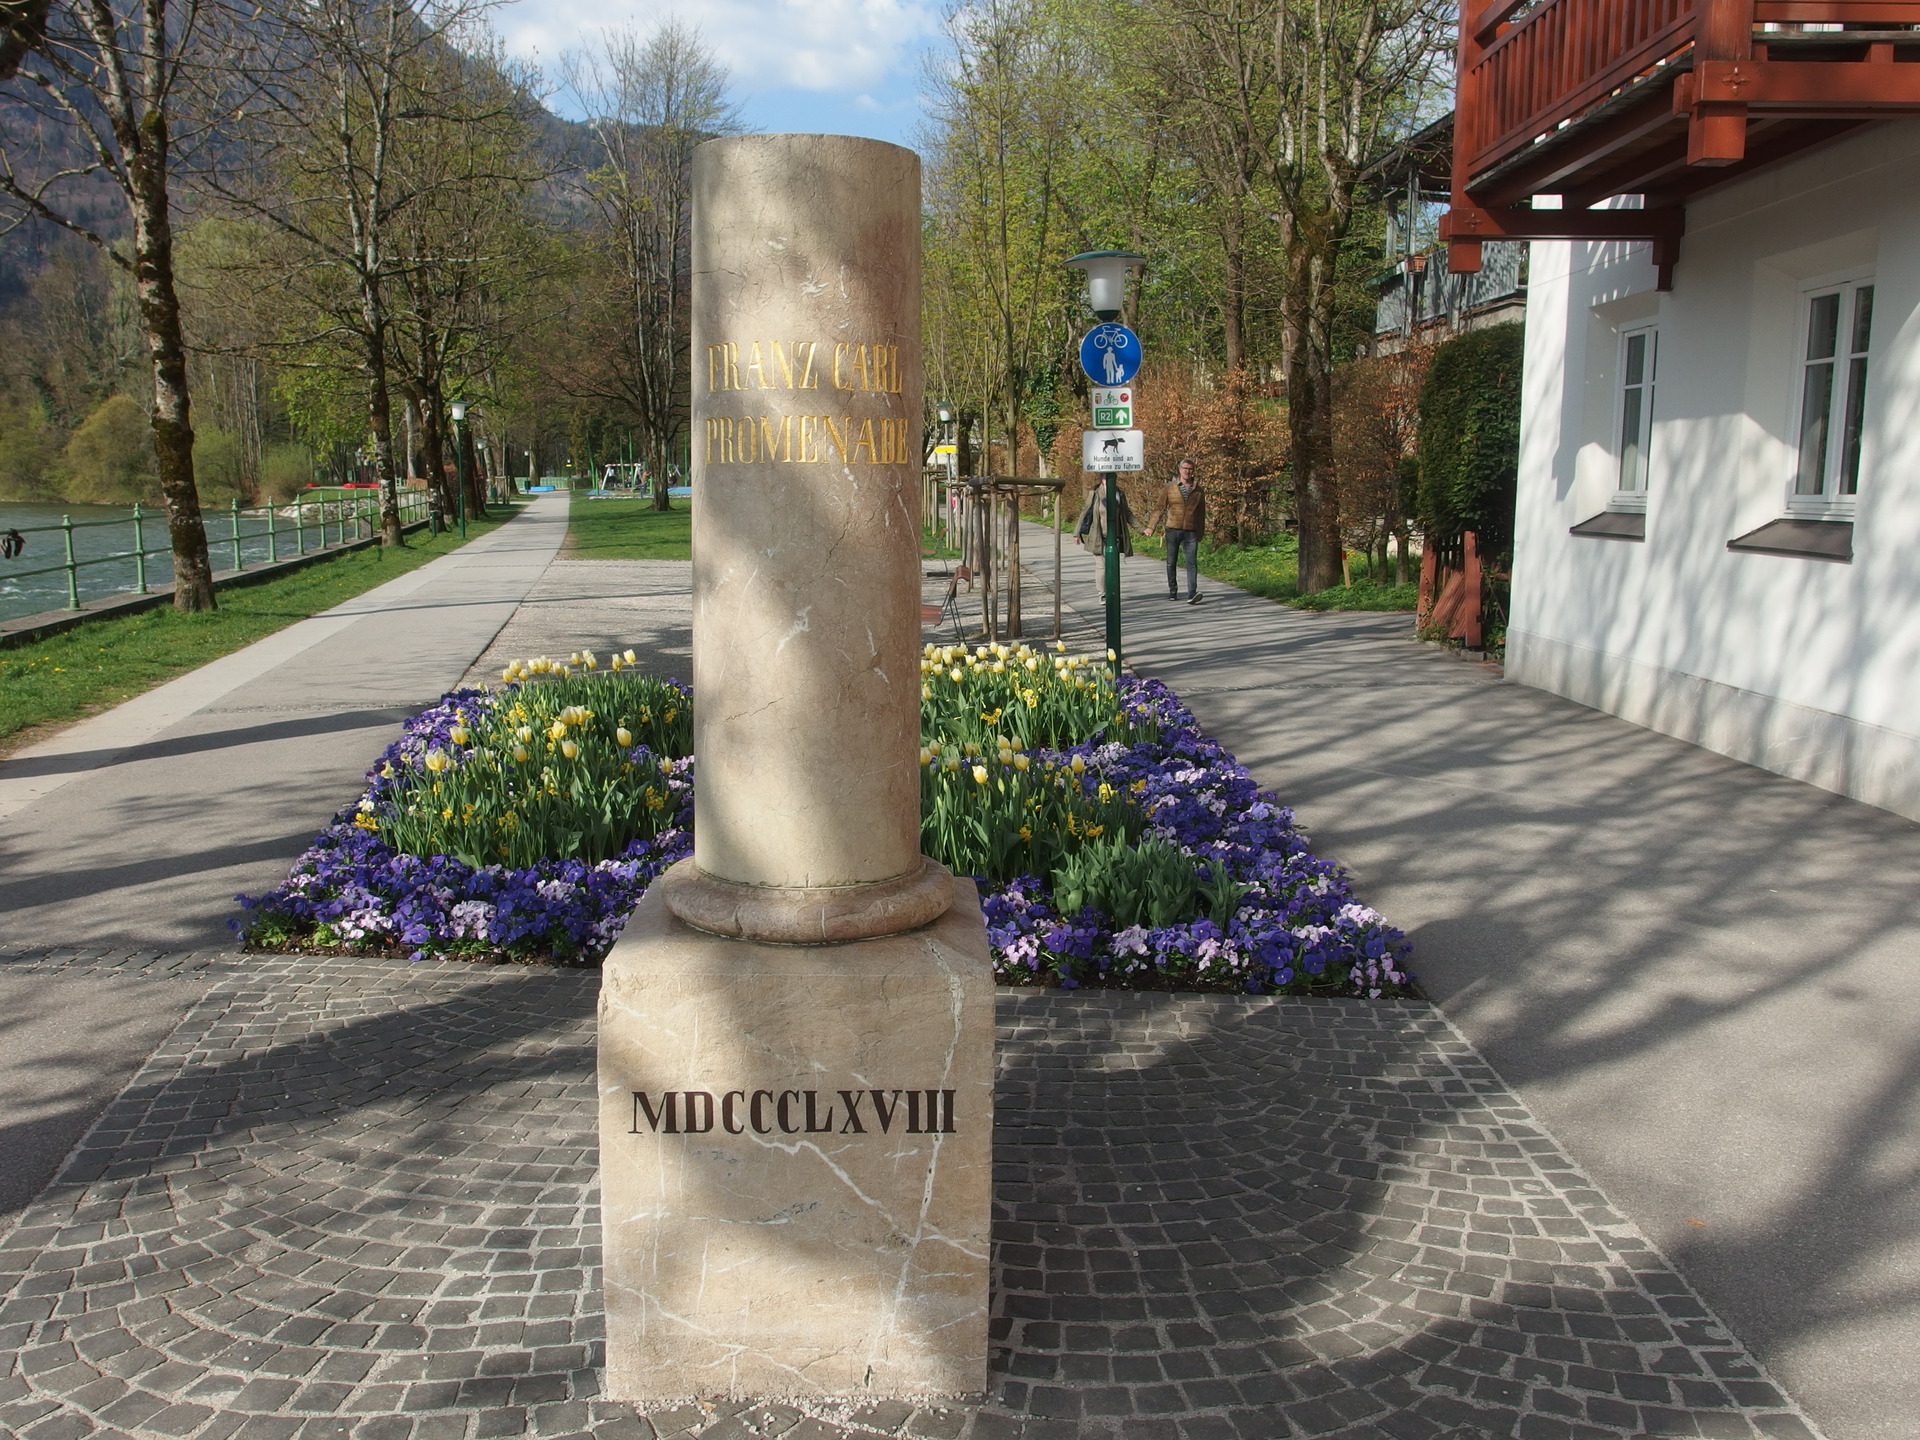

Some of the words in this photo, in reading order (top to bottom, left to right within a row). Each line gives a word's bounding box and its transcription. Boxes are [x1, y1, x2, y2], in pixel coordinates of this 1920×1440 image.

[705, 340, 818, 393] FRANZ
[832, 342, 903, 394] CARL
[1100, 412, 1111, 421] R2
[705, 415, 909, 465] PROMENADE
[1086, 463, 1096, 471] der
[628, 1089, 957, 1135] MDCCCLXVIII
